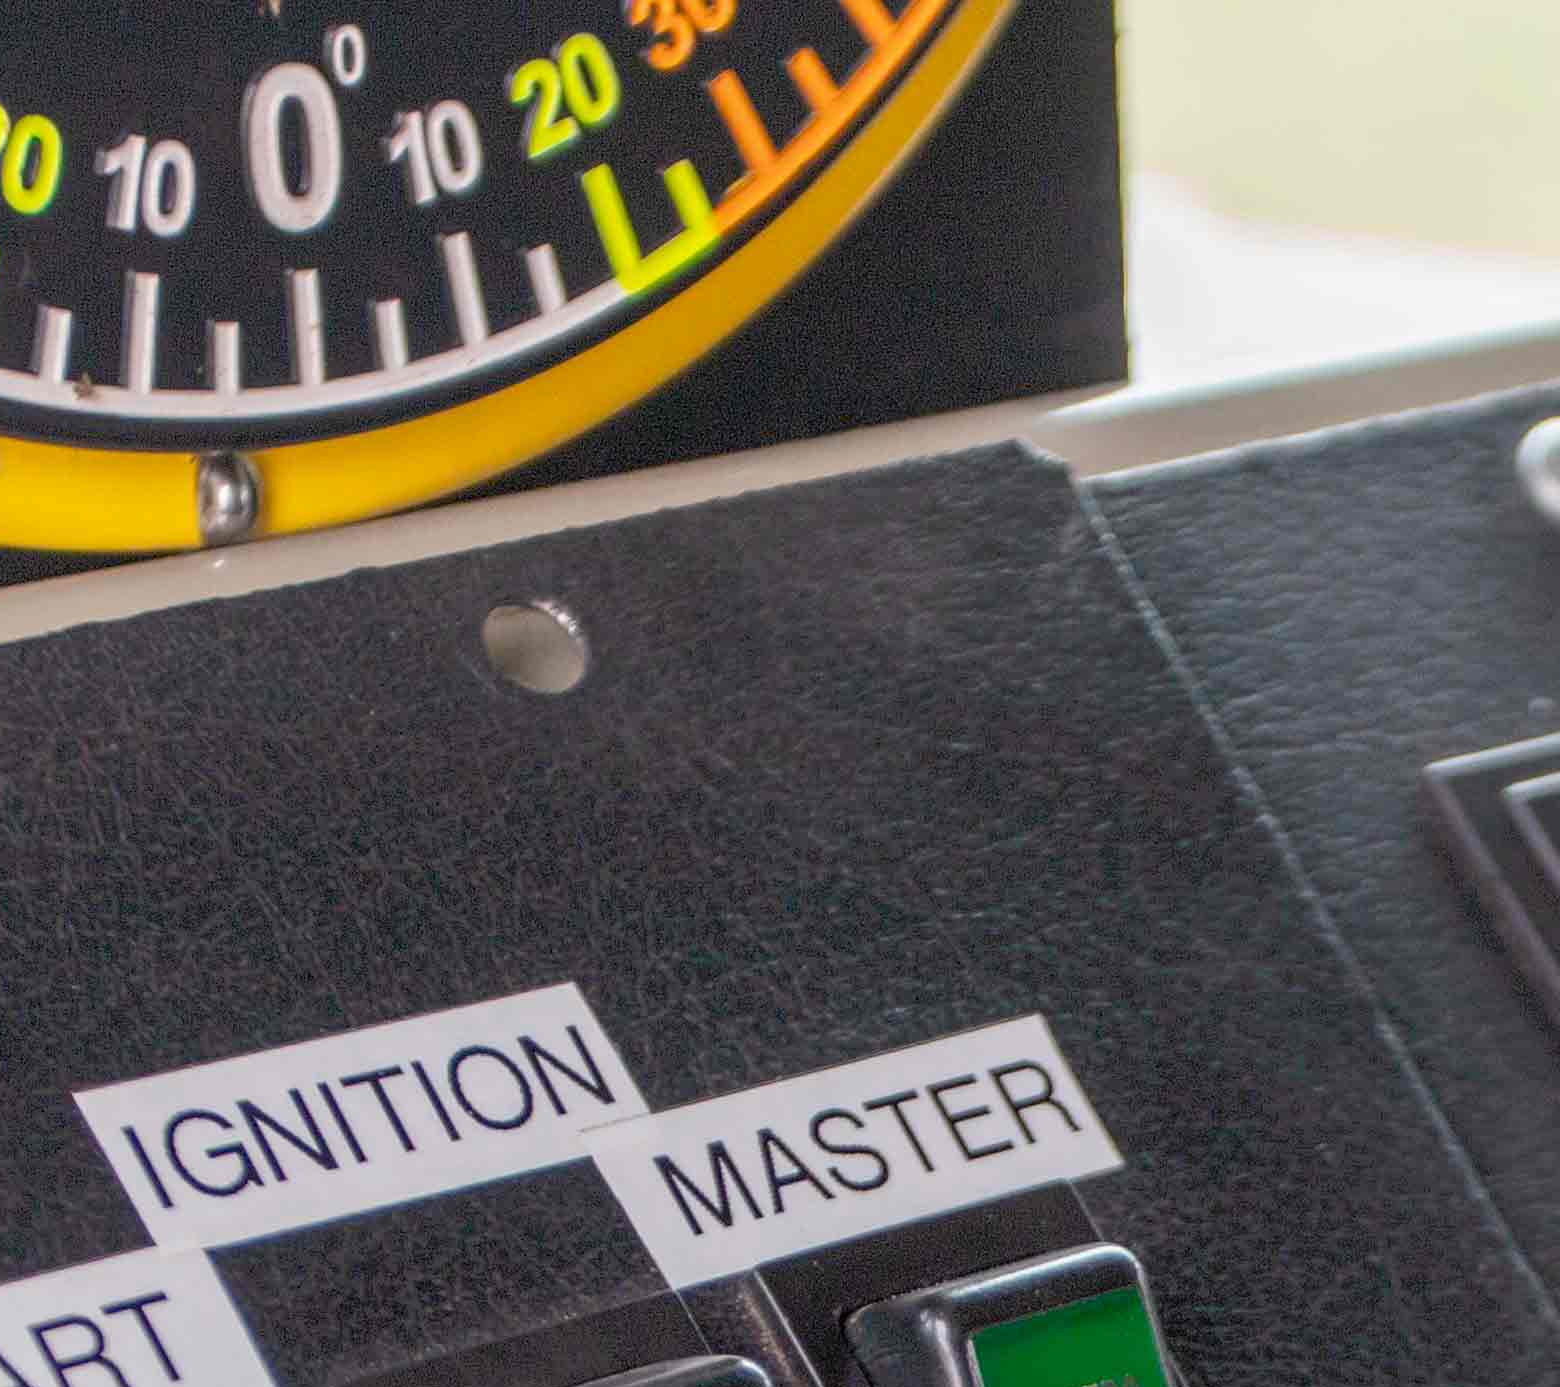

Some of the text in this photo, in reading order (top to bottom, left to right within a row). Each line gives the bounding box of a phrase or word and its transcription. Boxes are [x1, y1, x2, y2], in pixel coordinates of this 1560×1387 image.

[390, 100, 482, 203] 10
[510, 34, 618, 160] 20
[96, 134, 196, 238] 10
[123, 1024, 616, 1208] IGNITION
[652, 1058, 1083, 1237] MASTER
